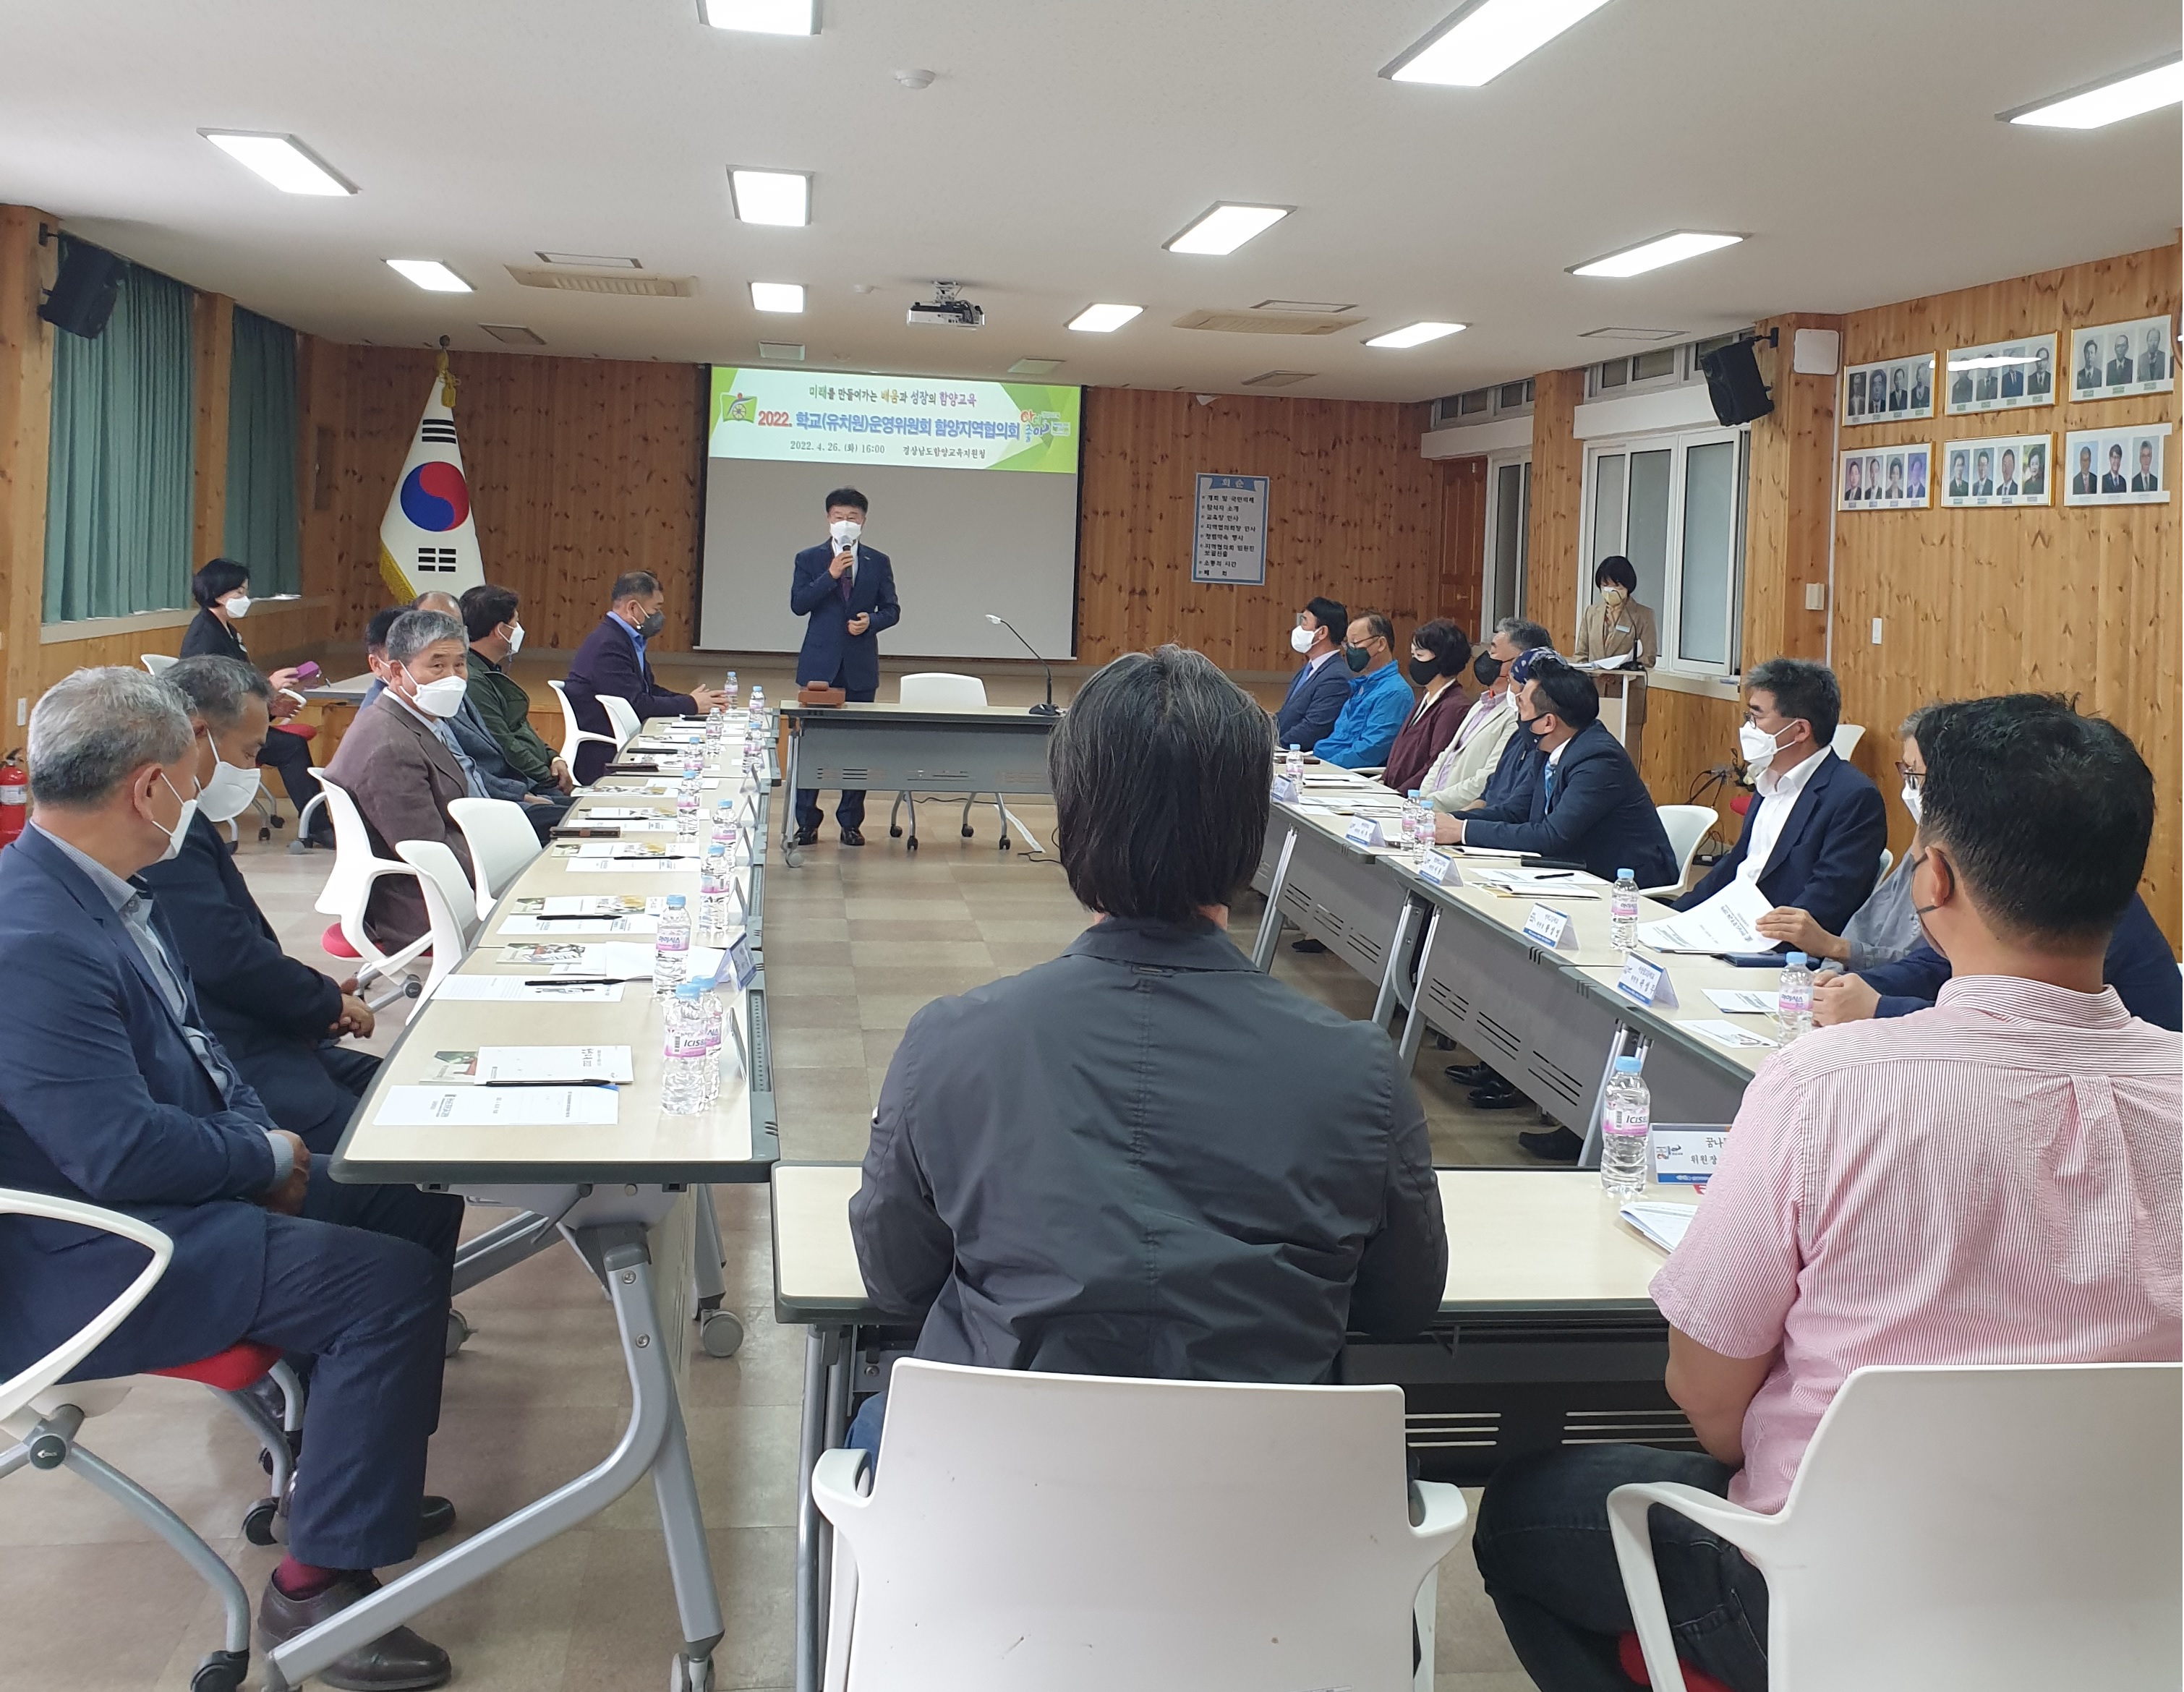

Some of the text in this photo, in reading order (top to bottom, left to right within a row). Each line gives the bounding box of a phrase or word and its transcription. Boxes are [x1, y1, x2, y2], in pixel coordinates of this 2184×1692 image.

[809, 384, 976, 407] 미래를 만들어가는 배움과 성장의 함양교육
[758, 411, 1020, 440] 2022. 학교(유치원)운영위원회 함양지역협의회
[790, 440, 986, 459] 2022. 4. 26. (화) 16:00 경상남도함양교육지원청
[1705, 1137, 1727, 1148] 꿈나
[1691, 1154, 1718, 1165] 위원장
